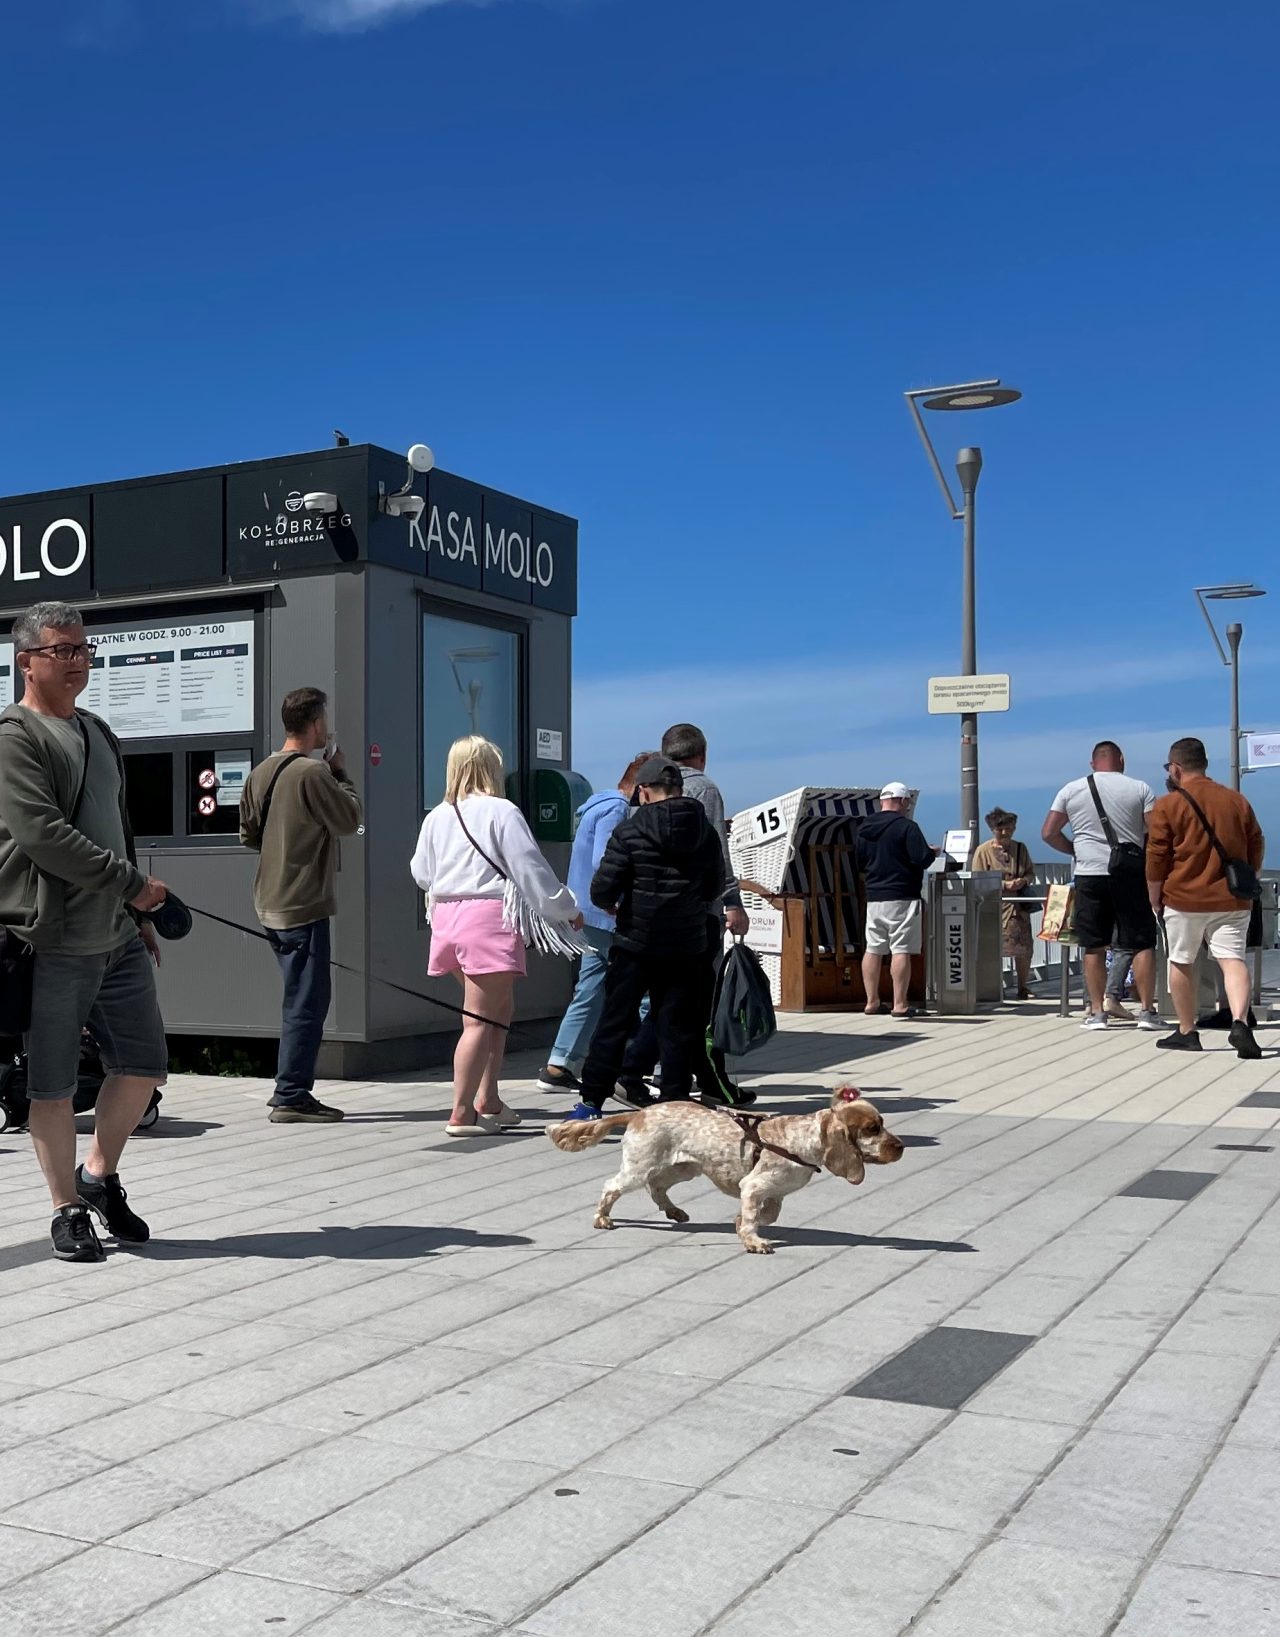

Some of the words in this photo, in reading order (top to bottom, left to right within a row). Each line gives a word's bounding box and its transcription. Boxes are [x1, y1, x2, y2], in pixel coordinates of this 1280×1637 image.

[240, 513, 352, 540] KOŁOBRZEG
[265, 533, 325, 547] RE:GENERACJA
[409, 504, 478, 566] KASA
[485, 522, 554, 587] MOLO
[90, 633, 125, 645] PŁATNE
[127, 632, 137, 642] W
[139, 630, 169, 640] GODZ.
[171, 627, 191, 638] 9.00
[200, 624, 225, 635] 21.00
[193, 650, 209, 658] PRICE
[210, 649, 222, 657] LIST
[539, 731, 551, 743] AED
[756, 806, 780, 835] 15
[749, 916, 776, 926] ORUM
[947, 924, 962, 984] WEJŚCIE
